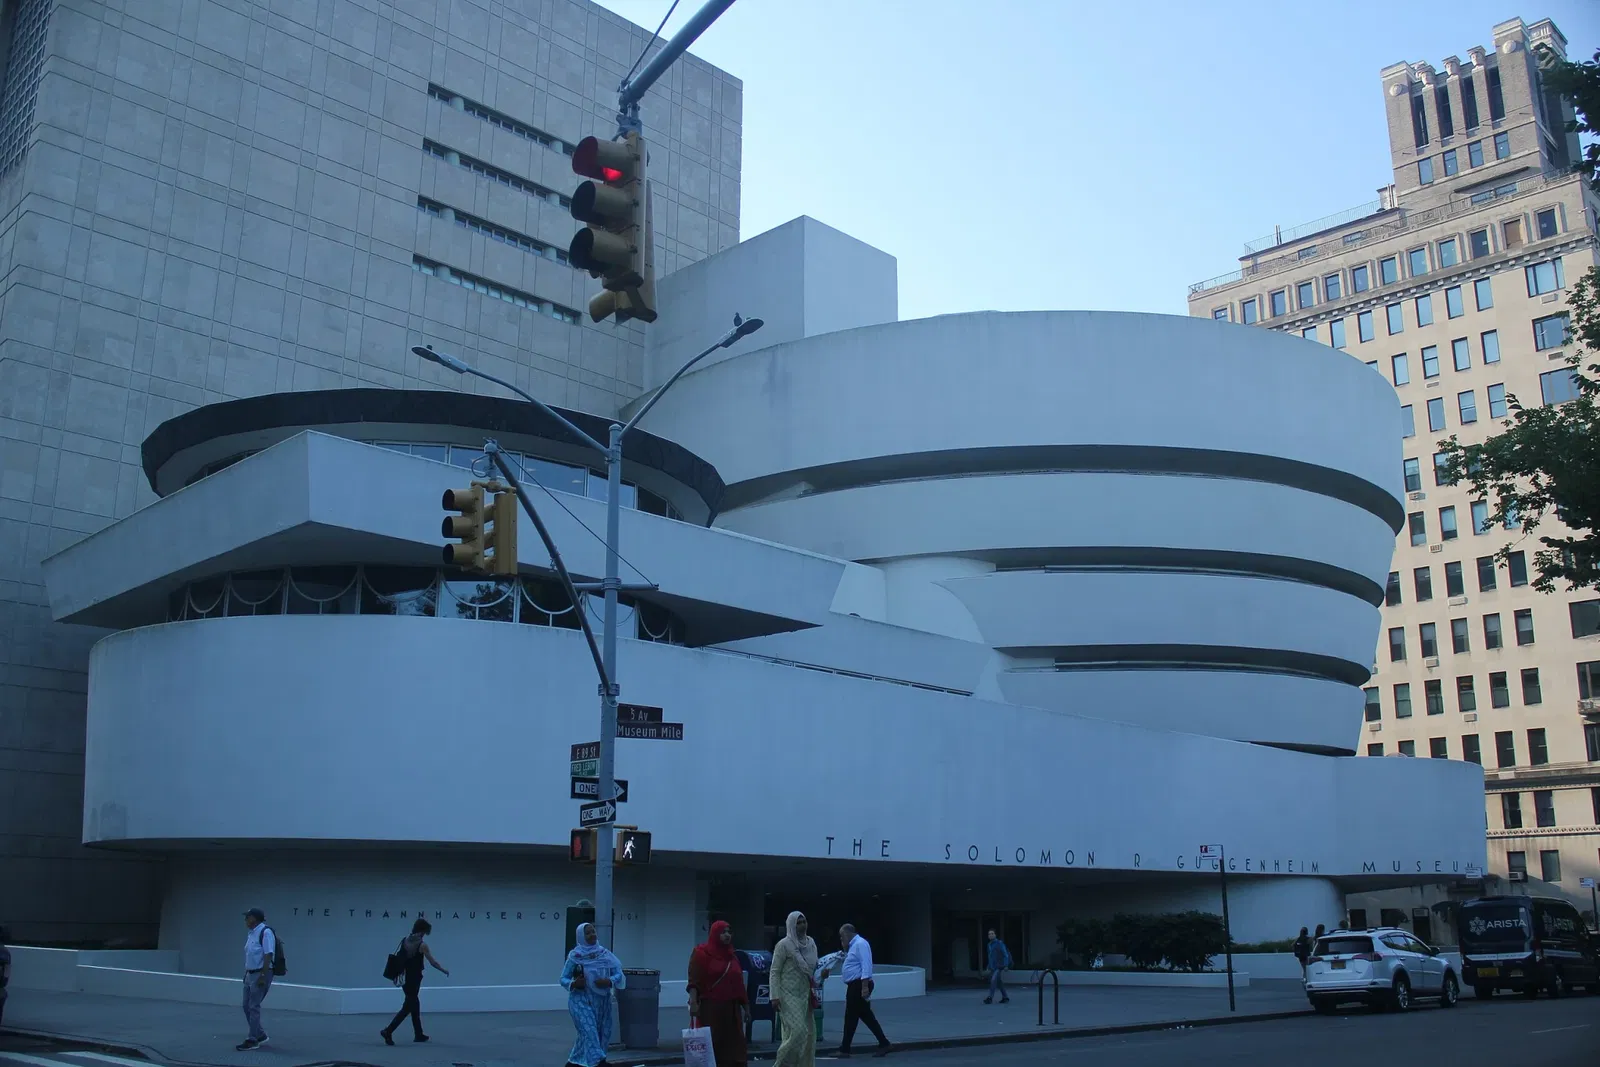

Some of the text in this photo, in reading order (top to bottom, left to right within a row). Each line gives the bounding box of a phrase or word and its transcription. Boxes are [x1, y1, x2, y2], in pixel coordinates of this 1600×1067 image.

[630, 707, 649, 721] 5 Av
[617, 724, 681, 738] Museum Mile
[590, 746, 596, 758] St
[580, 784, 596, 794] ONE
[582, 806, 611, 820] ONE WAY
[826, 836, 890, 857] THE
[944, 844, 1095, 866] SOLOMON
[1134, 853, 1141, 868] R
[1176, 855, 1319, 872] GUGGENHEIM
[293, 908, 331, 917] THE
[349, 909, 523, 920] THANNHAUSER
[1486, 919, 1527, 929] ARISTA
